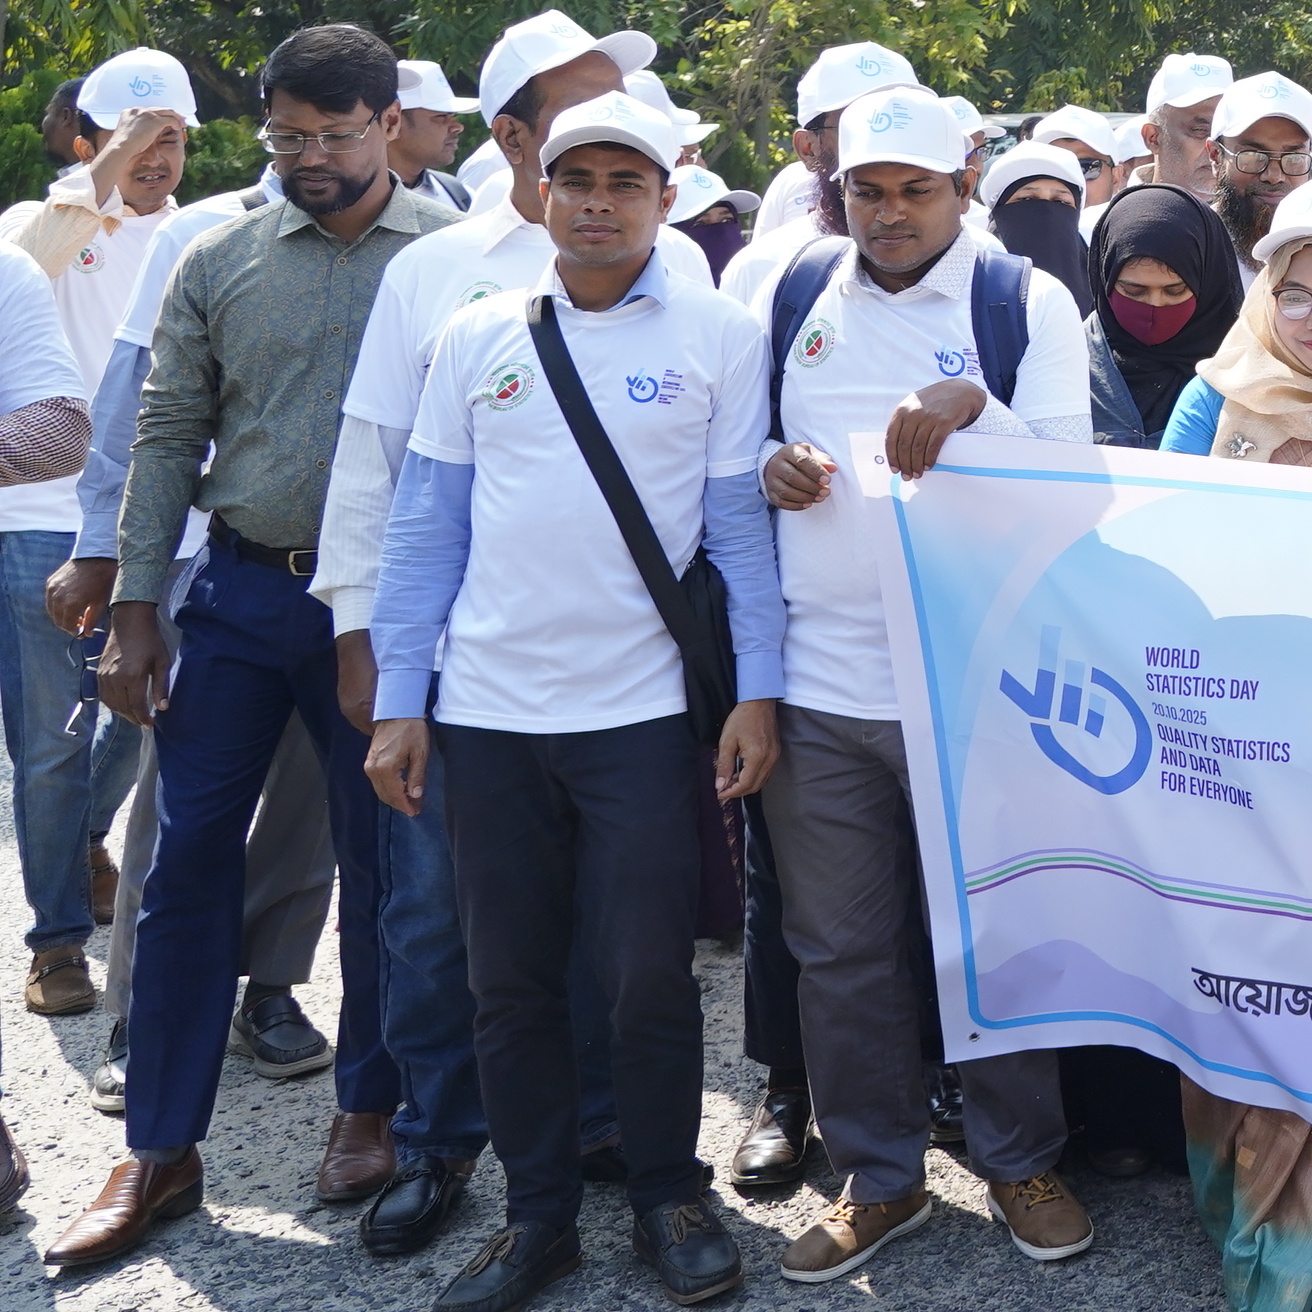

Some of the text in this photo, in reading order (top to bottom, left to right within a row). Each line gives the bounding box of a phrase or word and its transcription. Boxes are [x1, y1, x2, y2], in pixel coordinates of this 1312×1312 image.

[1145, 646, 1200, 669] WORLD
[1146, 673, 1259, 700] STATISTICS DAY
[1152, 702, 1207, 726] 20.10.2025
[1157, 723, 1290, 763] QUALITY STATISTICS
[1160, 746, 1222, 777] AND DATA
[1161, 771, 1254, 810] FOR EVERYONE
